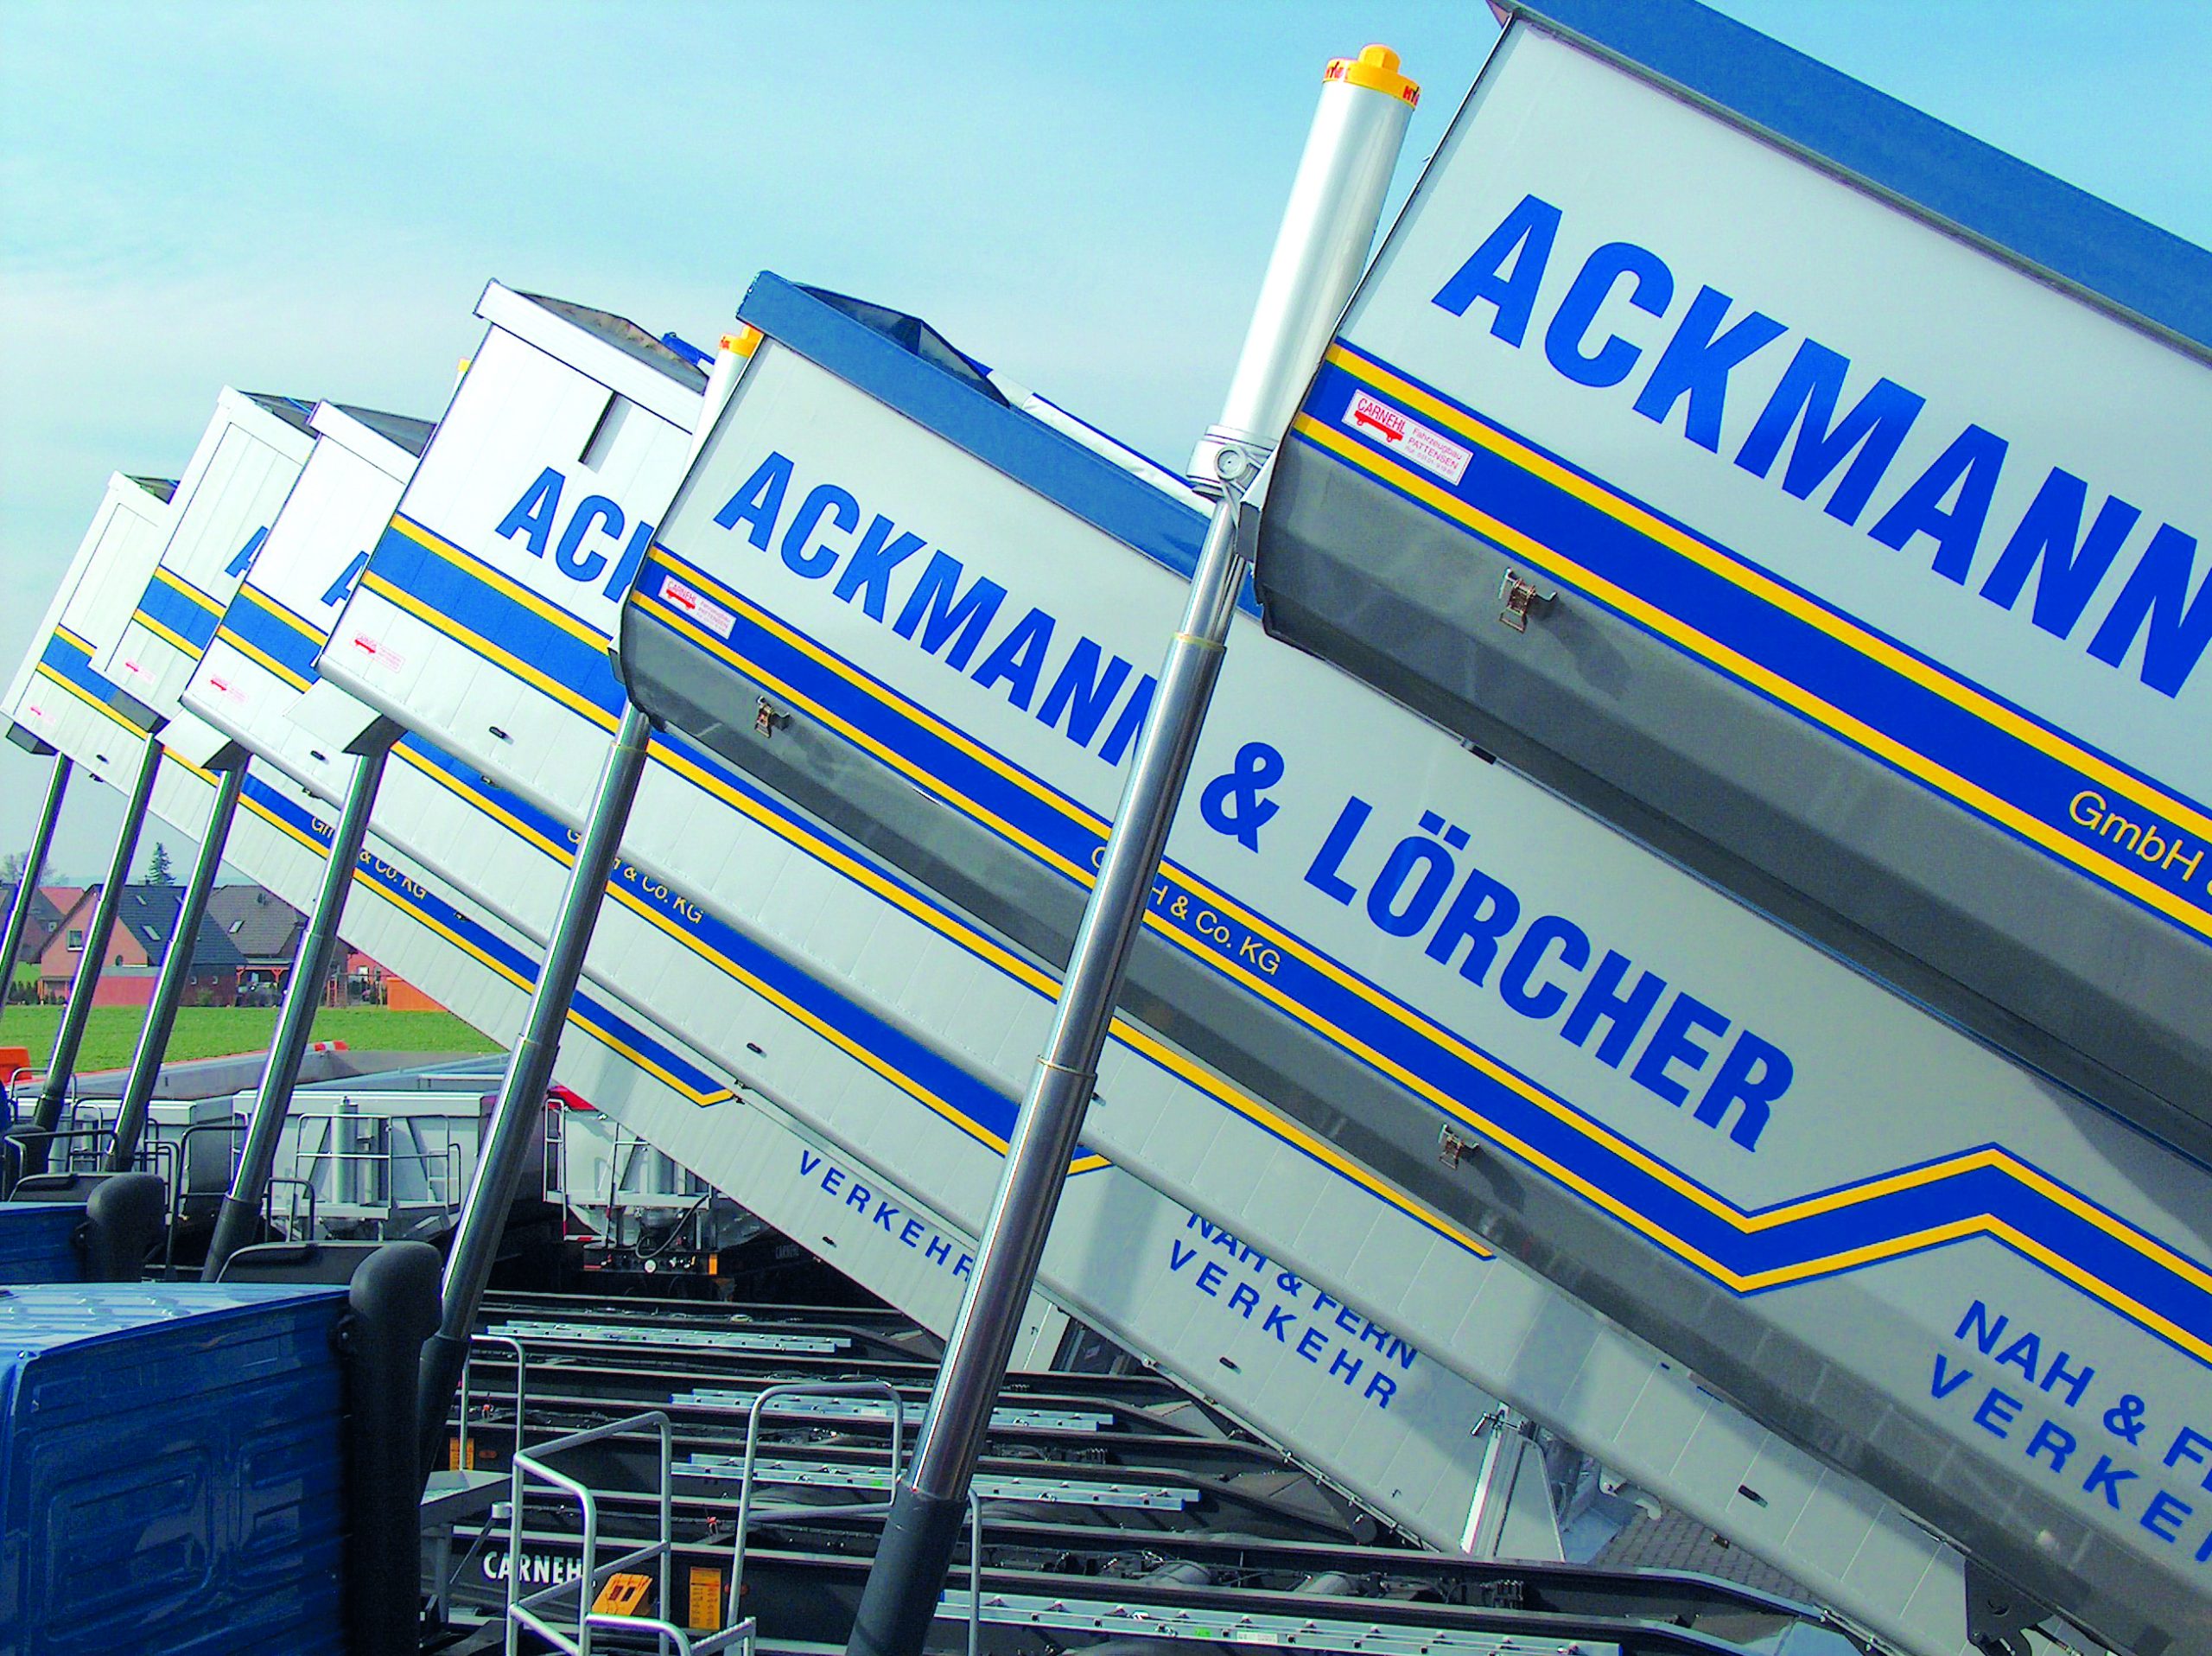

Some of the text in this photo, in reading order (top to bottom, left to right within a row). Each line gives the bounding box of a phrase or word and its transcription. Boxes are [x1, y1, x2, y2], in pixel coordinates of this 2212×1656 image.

[1357, 398, 1407, 435] CARNEHL
[1408, 436, 1459, 469] PATTENSEN
[1431, 194, 2212, 699] ACKMANN
[2069, 791, 2204, 882] GmbH
[1171, 895, 1188, 920] &
[1196, 911, 1231, 948] Co.
[1240, 936, 1281, 975] KG
[1200, 742, 1284, 854] &
[1304, 796, 1794, 1154] LÖRCHER
[1171, 1239, 1397, 1409] VERKEHR
[1931, 1353, 2212, 1563] VERKE
[1955, 1300, 2212, 1493] NAH & F
[484, 1551, 596, 1587] CARNEH
